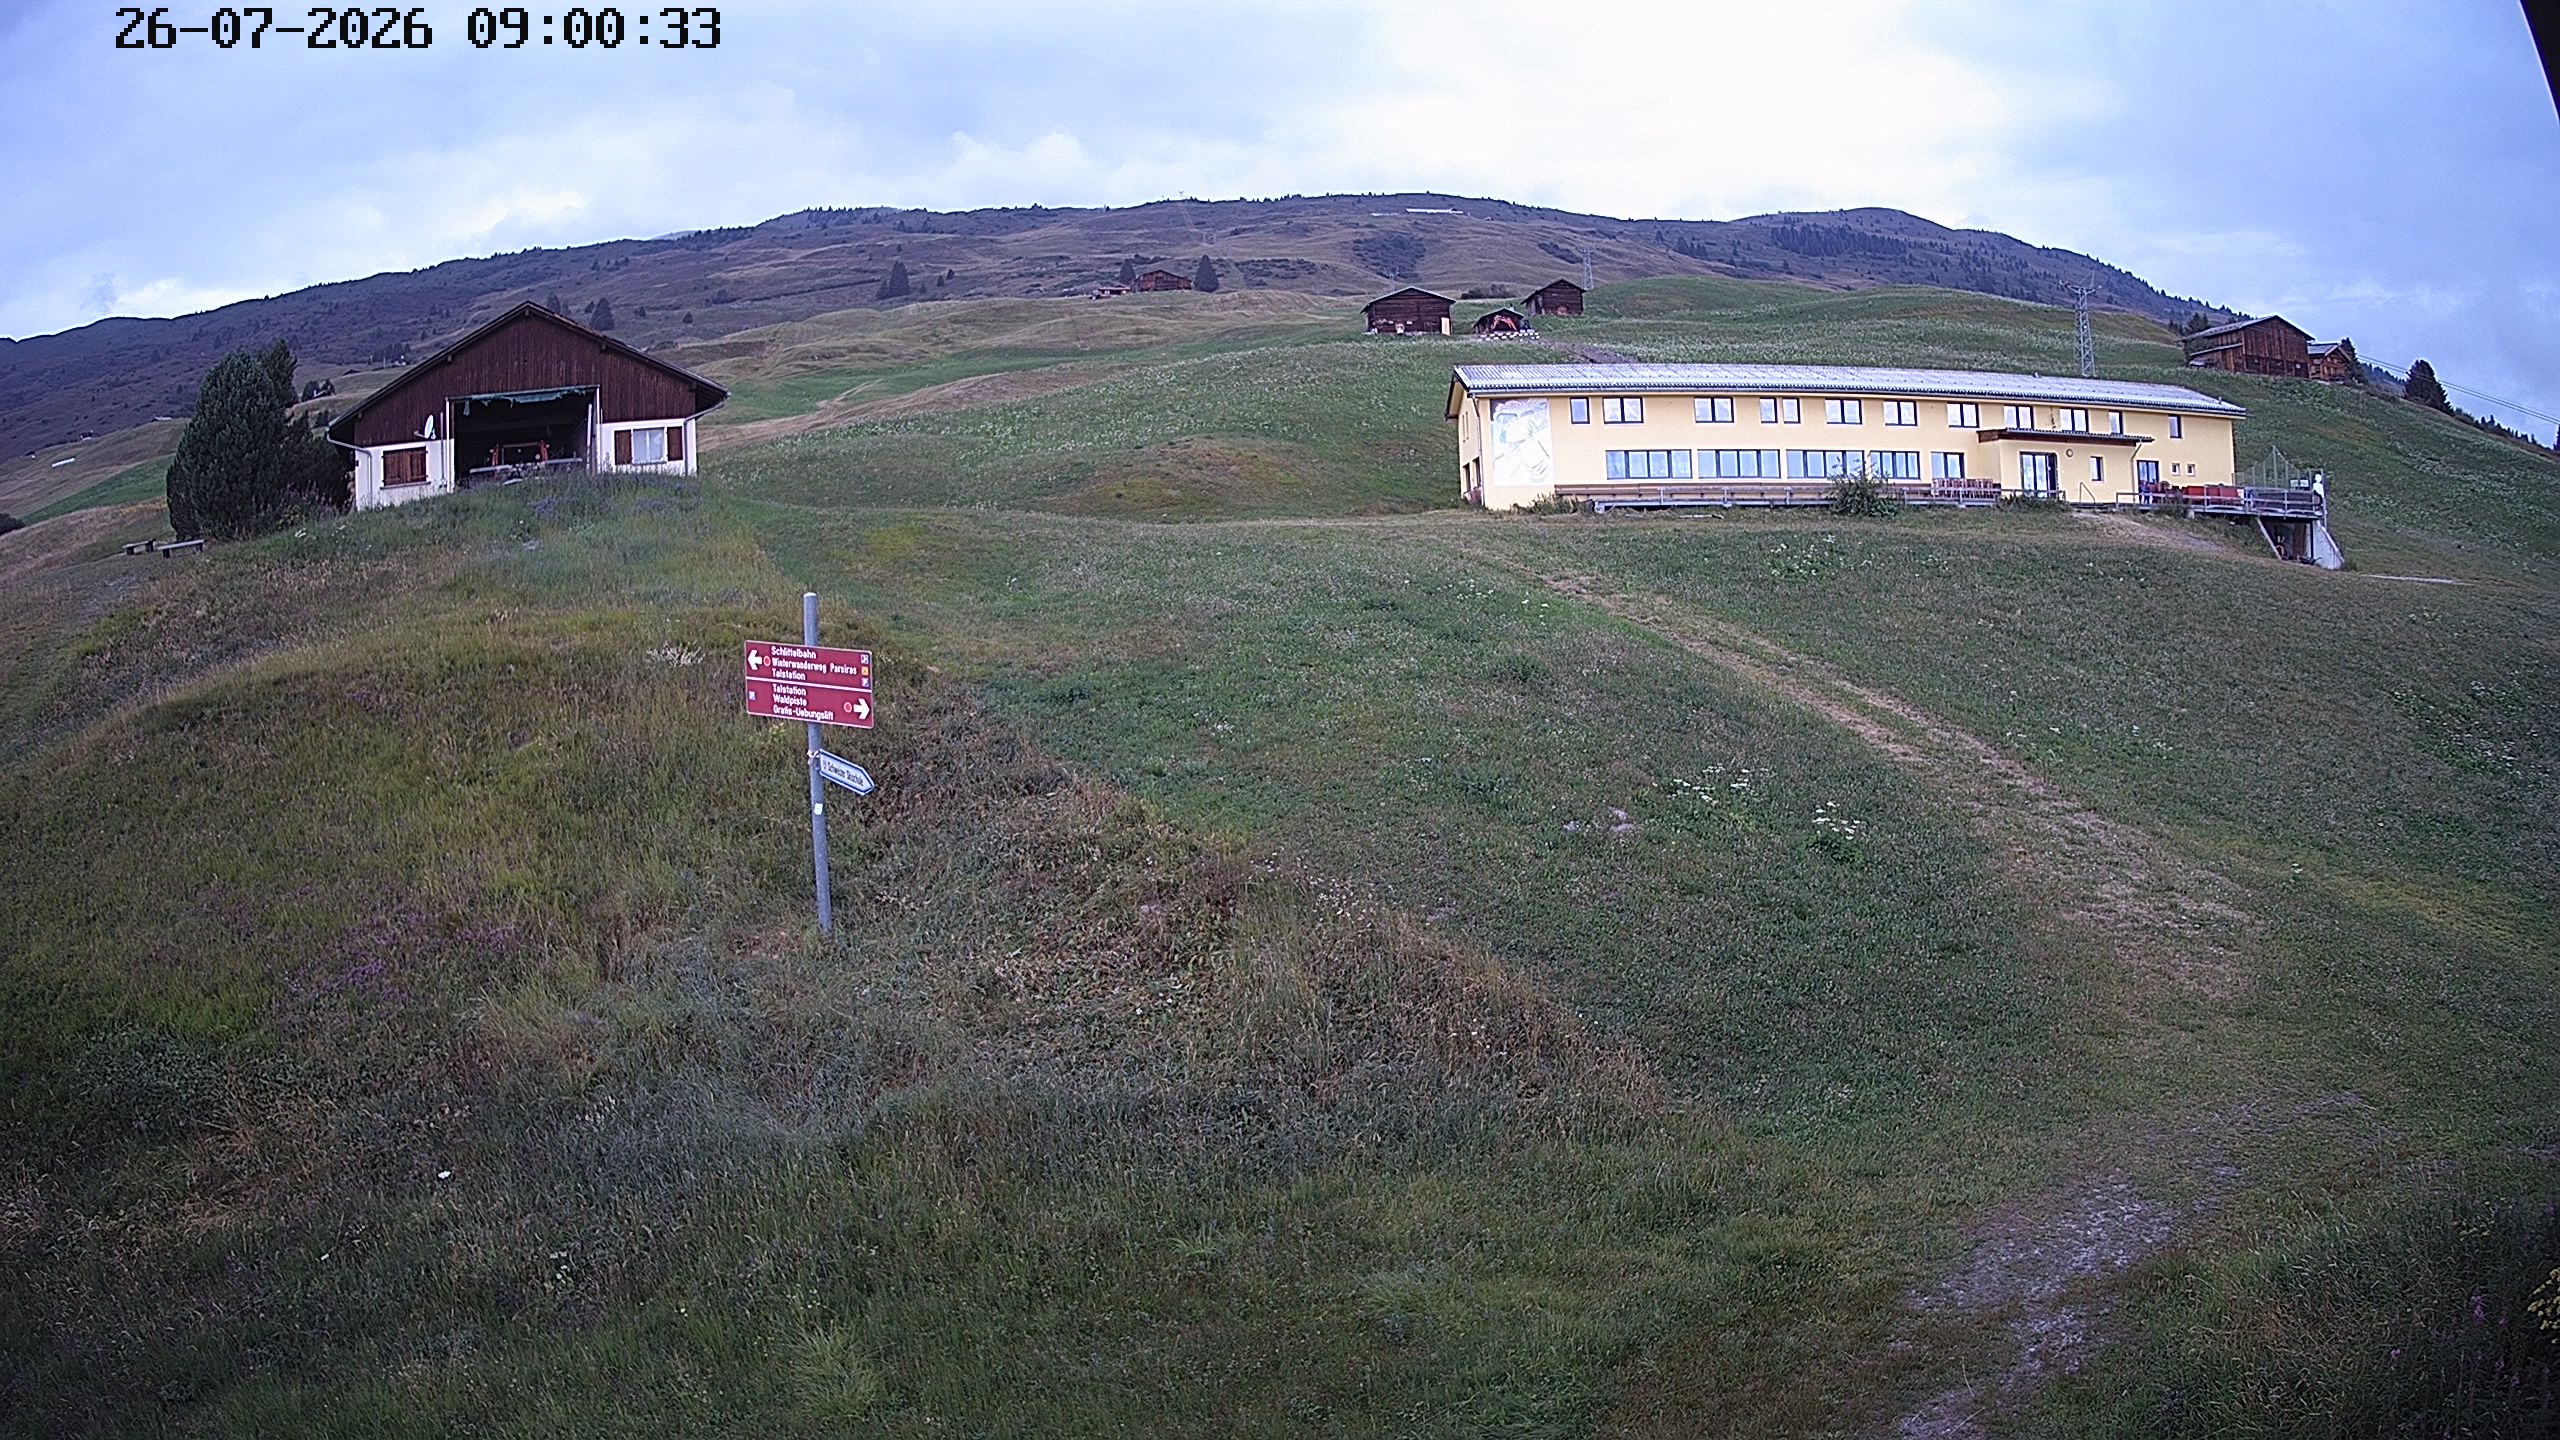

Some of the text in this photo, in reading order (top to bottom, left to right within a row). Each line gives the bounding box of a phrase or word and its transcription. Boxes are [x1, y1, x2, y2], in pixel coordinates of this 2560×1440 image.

[771, 645, 817, 659] Schlittelbahn
[771, 667, 806, 681] Talstation
[772, 683, 807, 696] Talstation
[773, 694, 808, 707] Waldpiste
